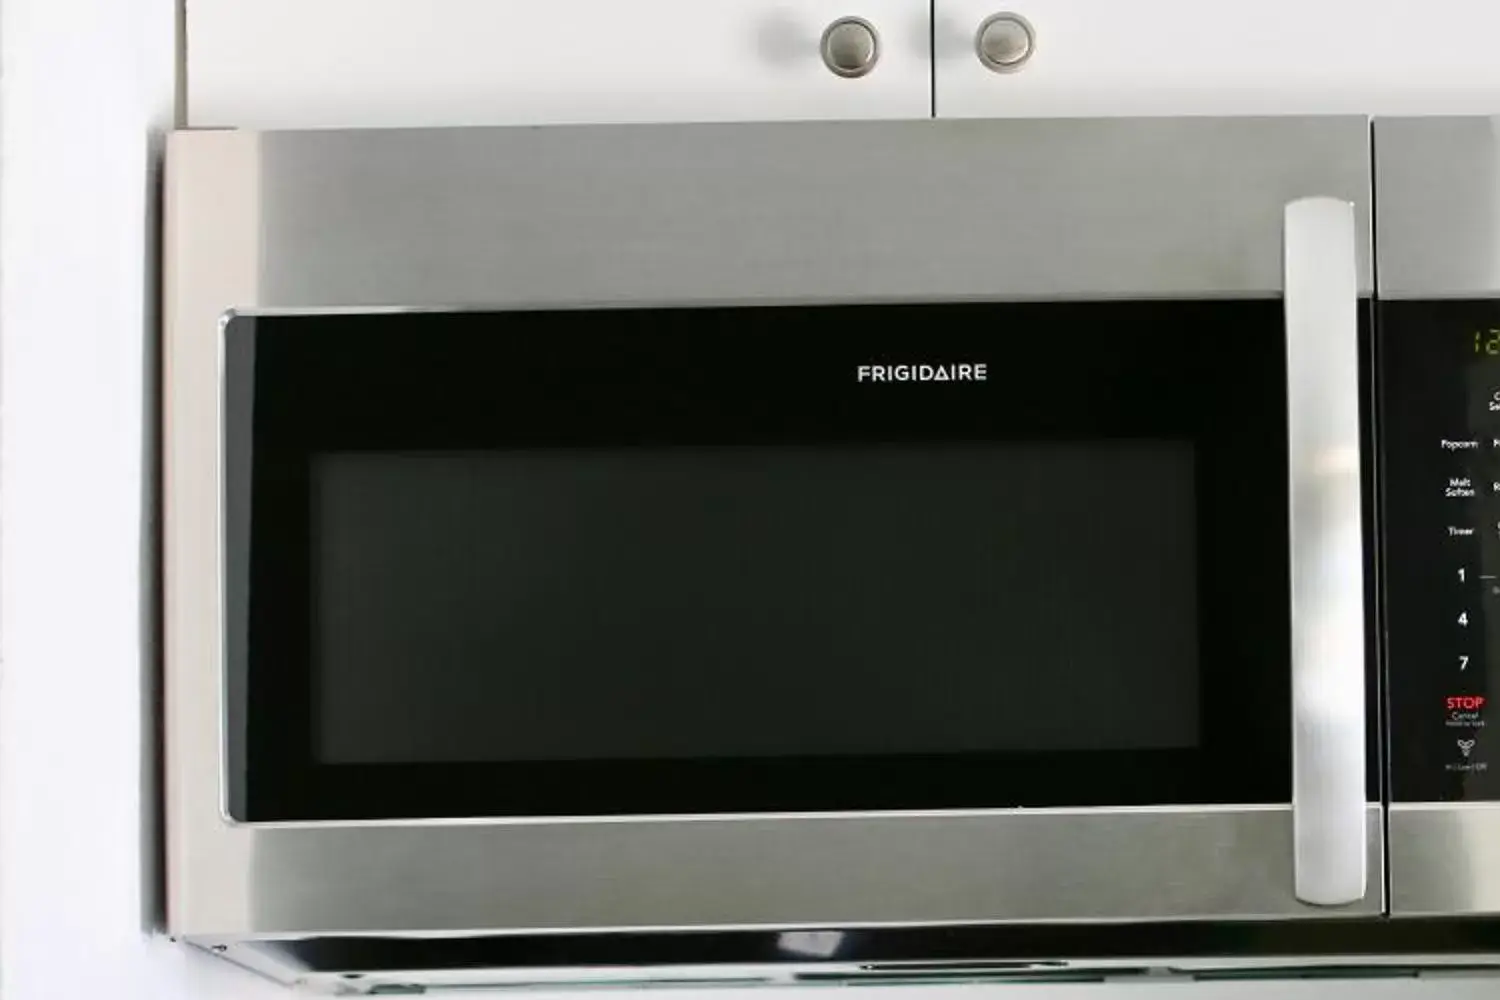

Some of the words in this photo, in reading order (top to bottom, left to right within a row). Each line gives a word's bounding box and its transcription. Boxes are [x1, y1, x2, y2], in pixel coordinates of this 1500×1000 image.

[858, 364, 986, 382] FRIGIDAIRE
[1440, 439, 1479, 452] Popcorn
[1444, 487, 1476, 497] Soften
[1448, 526, 1475, 536] Timer
[1457, 567, 1465, 583] 1
[1457, 611, 1469, 627] 4
[1459, 655, 1469, 671] 7
[1447, 696, 1484, 710] STOP
